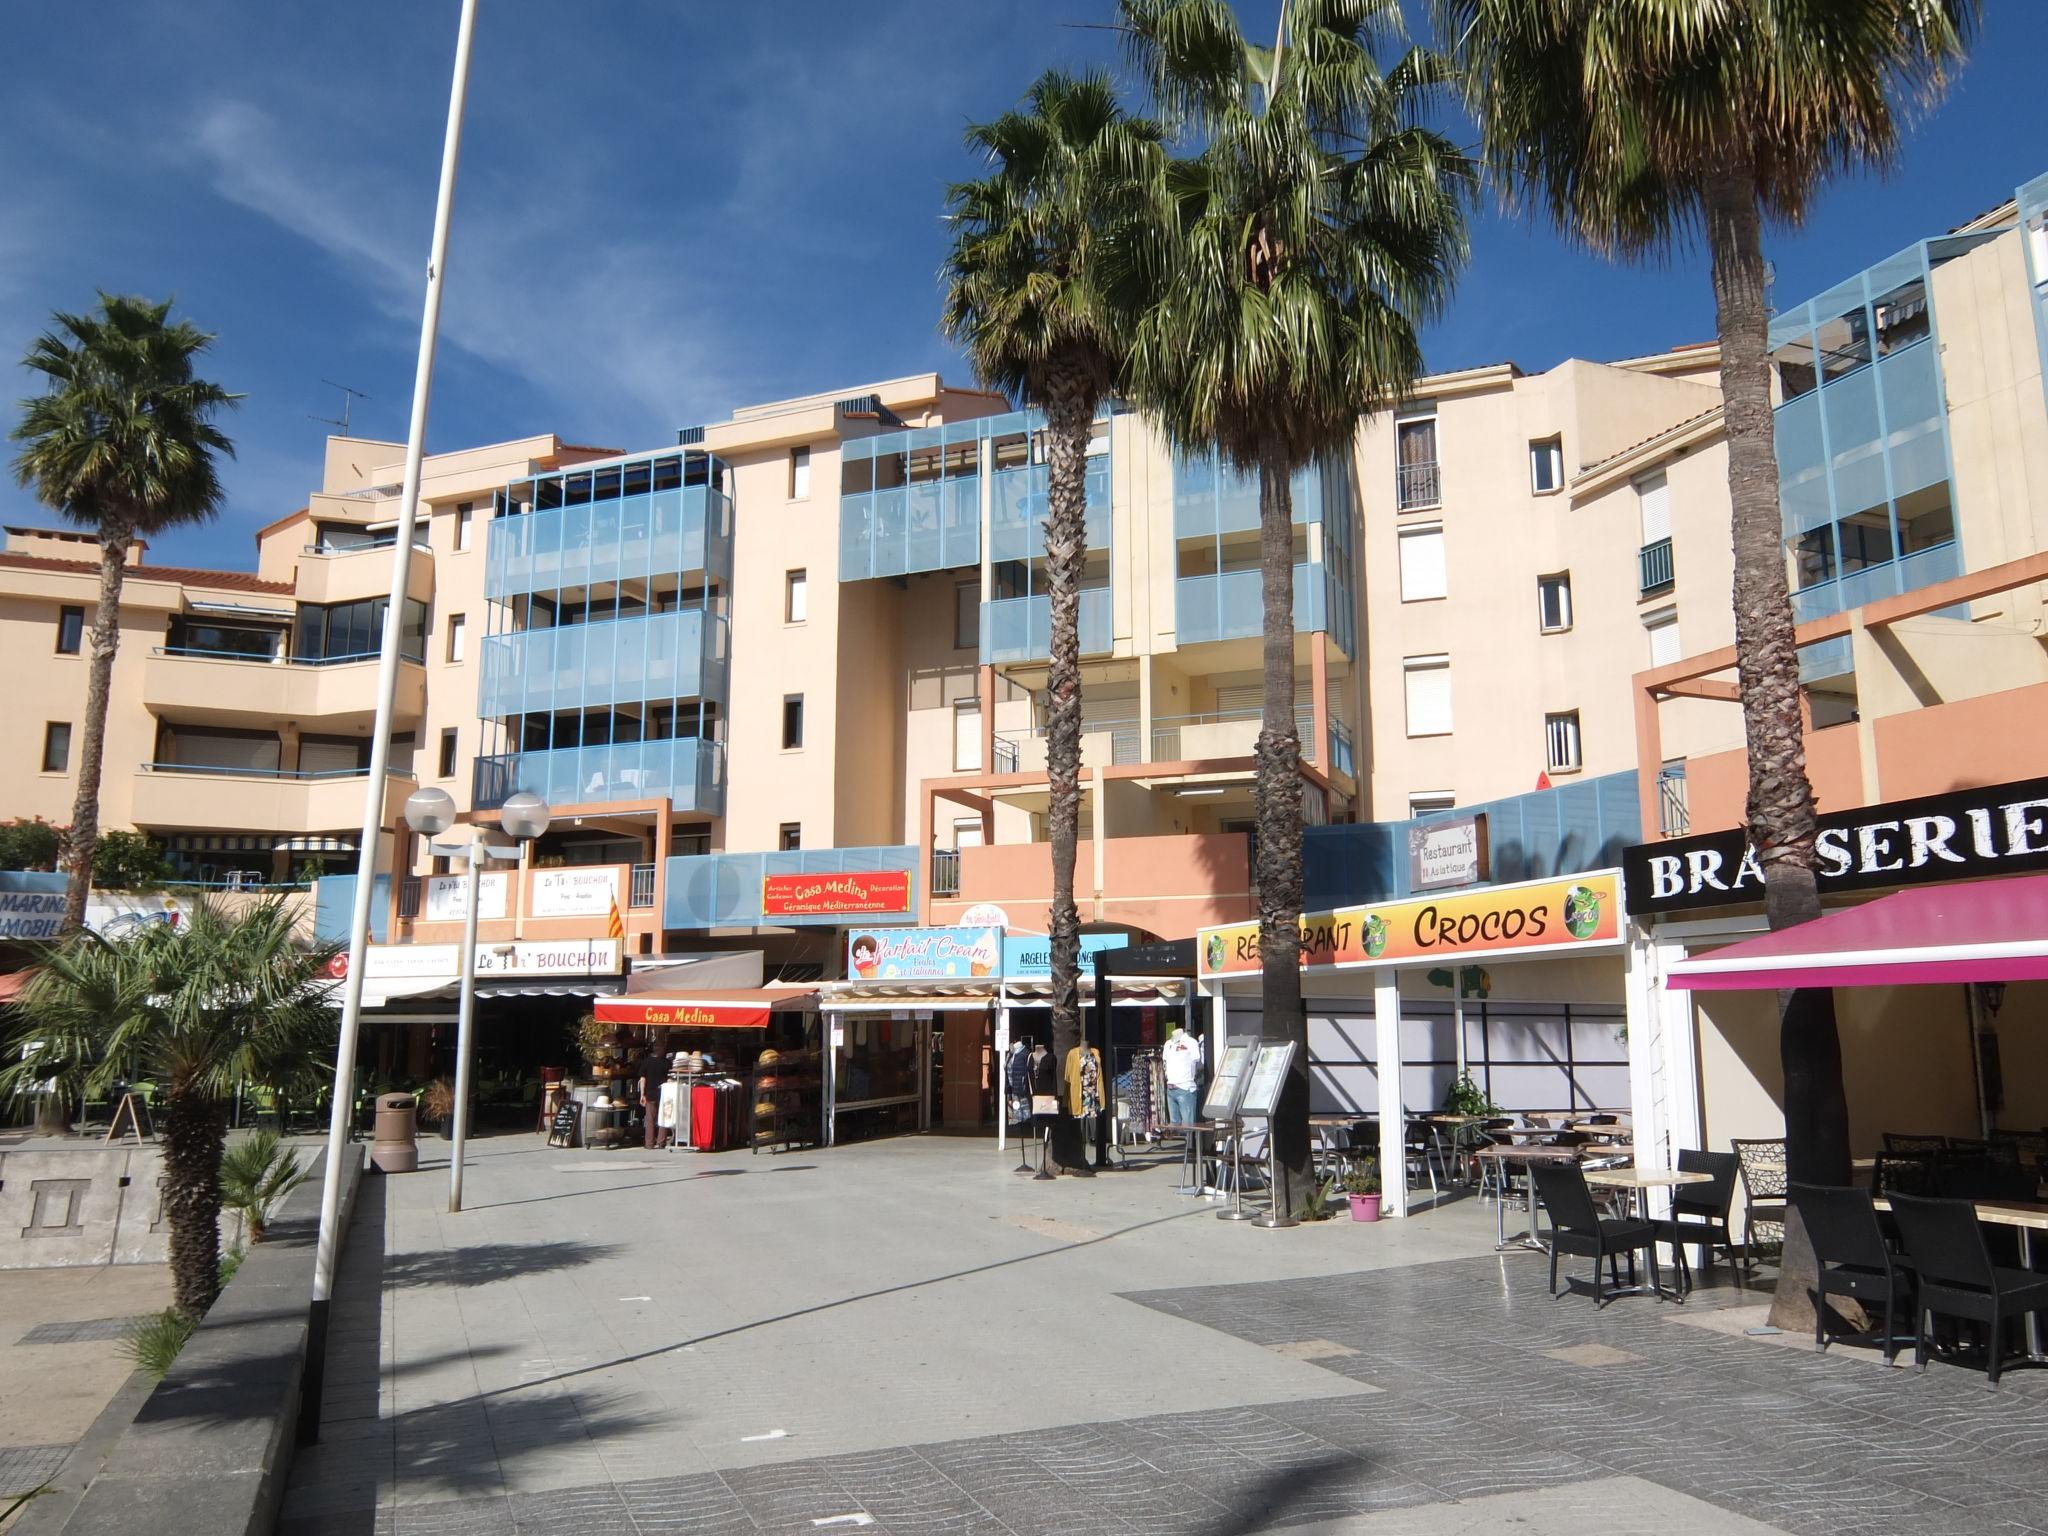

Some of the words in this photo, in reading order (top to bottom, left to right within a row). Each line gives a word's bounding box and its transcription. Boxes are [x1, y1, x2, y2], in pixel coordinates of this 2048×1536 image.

[1423, 841, 1473, 861] Restaurant
[1648, 798, 2048, 899] BRASERIE
[1430, 863, 1467, 878] Asiatique
[795, 884, 822, 900] Casa
[823, 878, 868, 900] Medina
[870, 883, 906, 892] Décoration
[0, 894, 67, 914] MARIN
[783, 901, 821, 912] Céramique
[823, 899, 886, 910] Méditerranéenne
[873, 936, 931, 965] Parfait
[936, 936, 991, 961] Cream
[1236, 922, 1352, 962] RERANT
[477, 953, 493, 969] Le
[536, 952, 608, 968] BOUCHON
[645, 1007, 670, 1023] Casa
[674, 1007, 715, 1024] Medina
